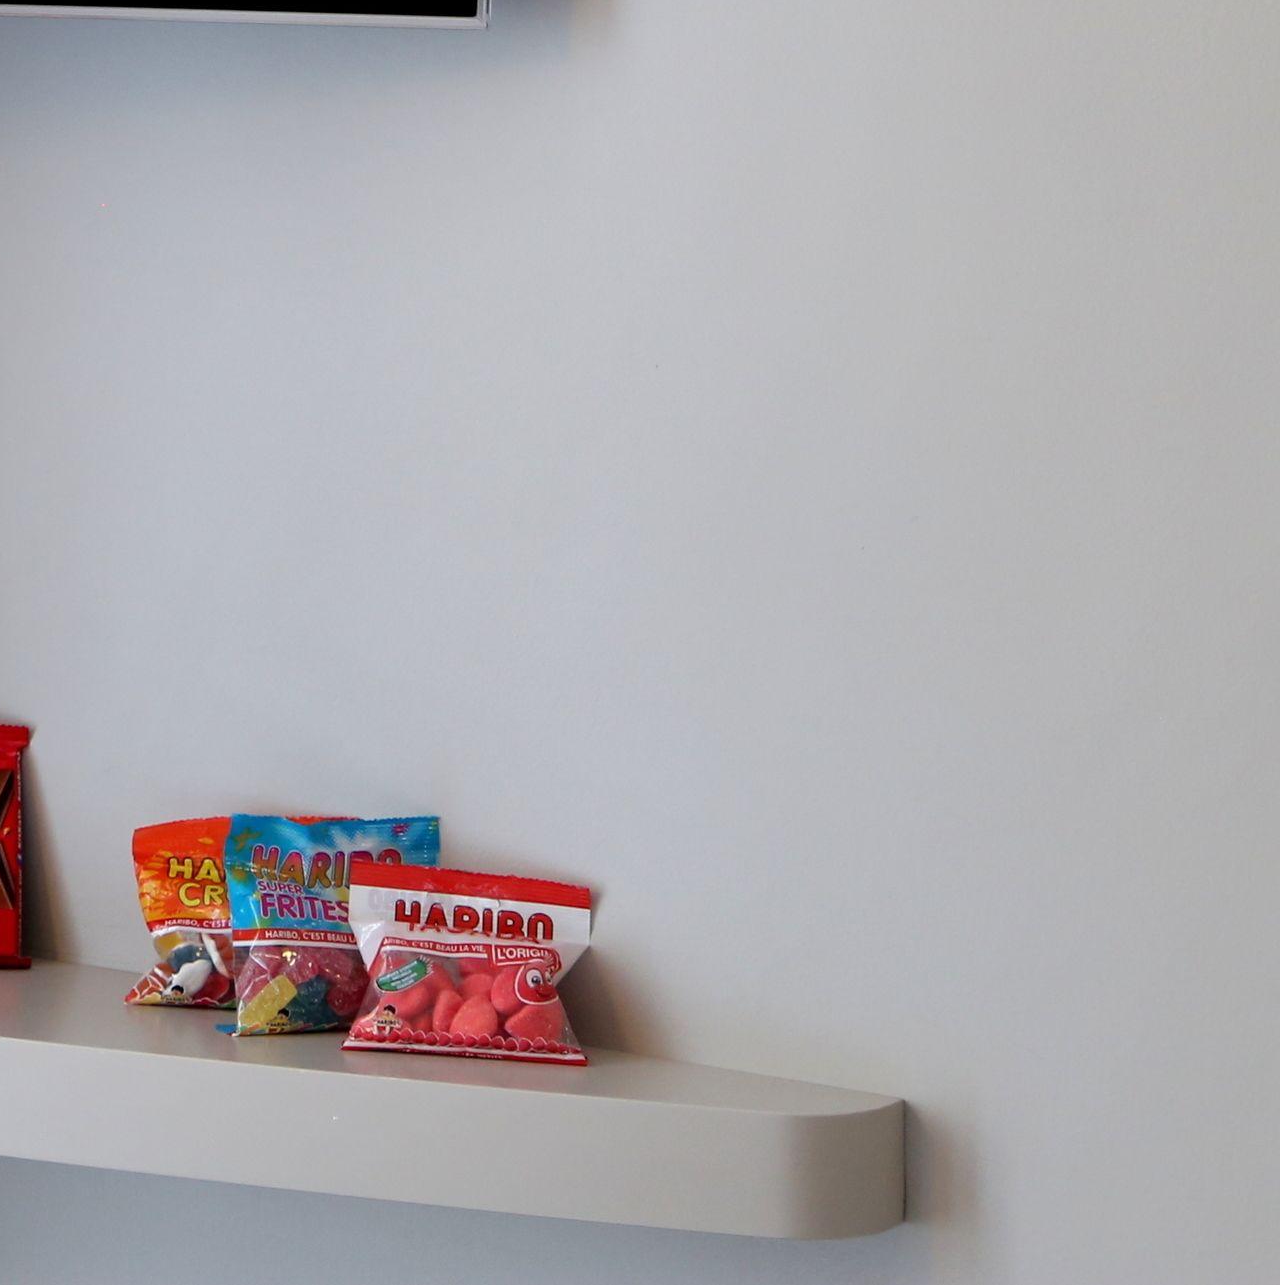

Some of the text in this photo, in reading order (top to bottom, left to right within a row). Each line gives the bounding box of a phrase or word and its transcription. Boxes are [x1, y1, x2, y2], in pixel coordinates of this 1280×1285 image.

[168, 857, 226, 884] HA
[178, 882, 230, 908] CR
[258, 881, 303, 895] SUPER
[260, 892, 350, 923] FRITES
[265, 930, 301, 940] HARIBO,
[303, 931, 325, 940] C'EST
[327, 933, 347, 943] BEAU
[436, 943, 458, 952] BEAU
